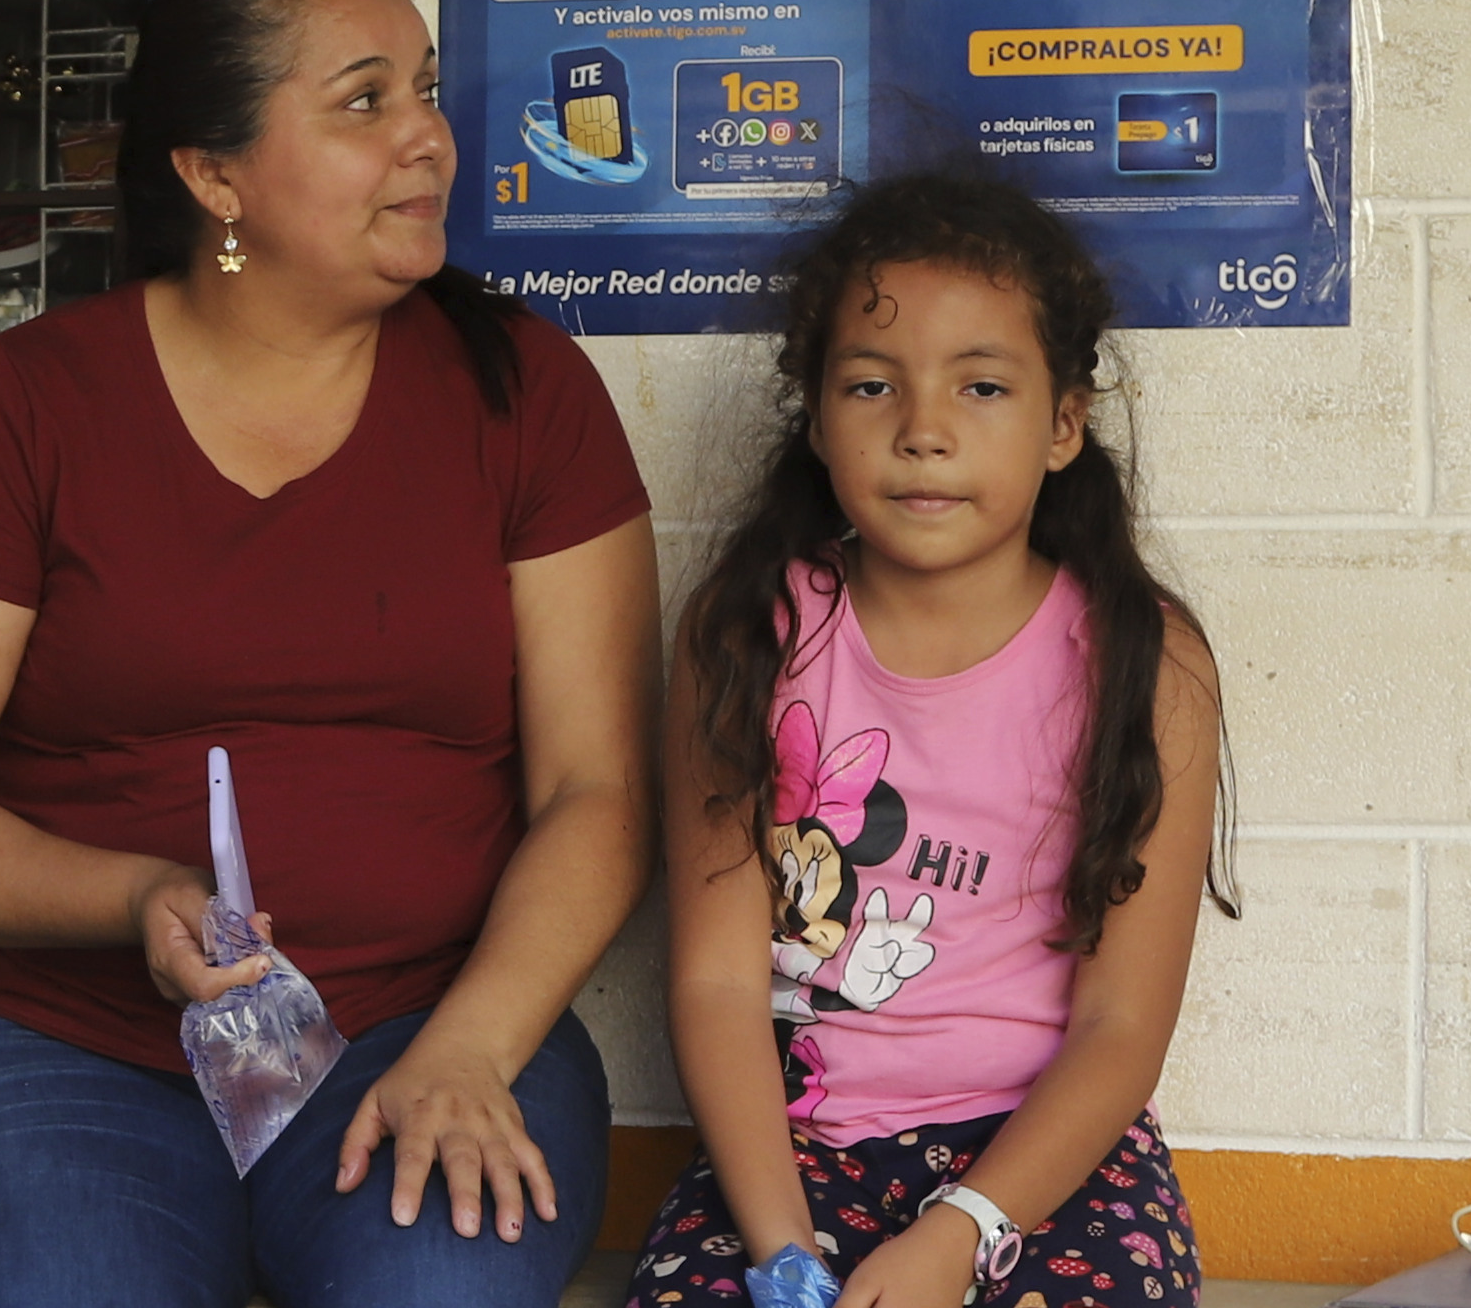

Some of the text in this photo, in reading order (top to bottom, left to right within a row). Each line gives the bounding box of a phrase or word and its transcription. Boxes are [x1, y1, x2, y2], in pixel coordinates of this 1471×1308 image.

[555, 3, 800, 24] Y activalo vos mismo en
[988, 37, 1222, 66] ¡COMPRALOS YA!
[570, 63, 603, 89] LTE
[721, 72, 799, 112] 1GB
[980, 116, 1095, 137] o adquirilos en
[1173, 116, 1199, 143] $1
[980, 138, 1095, 157] tarjetas físicas
[495, 164, 510, 175] Por
[496, 162, 528, 204] $1
[483, 271, 516, 295] La
[522, 270, 606, 301] Mejor
[608, 269, 666, 295] Red
[669, 268, 763, 294] donde
[1218, 256, 1297, 299] tigo
[907, 834, 990, 896] Hi!
